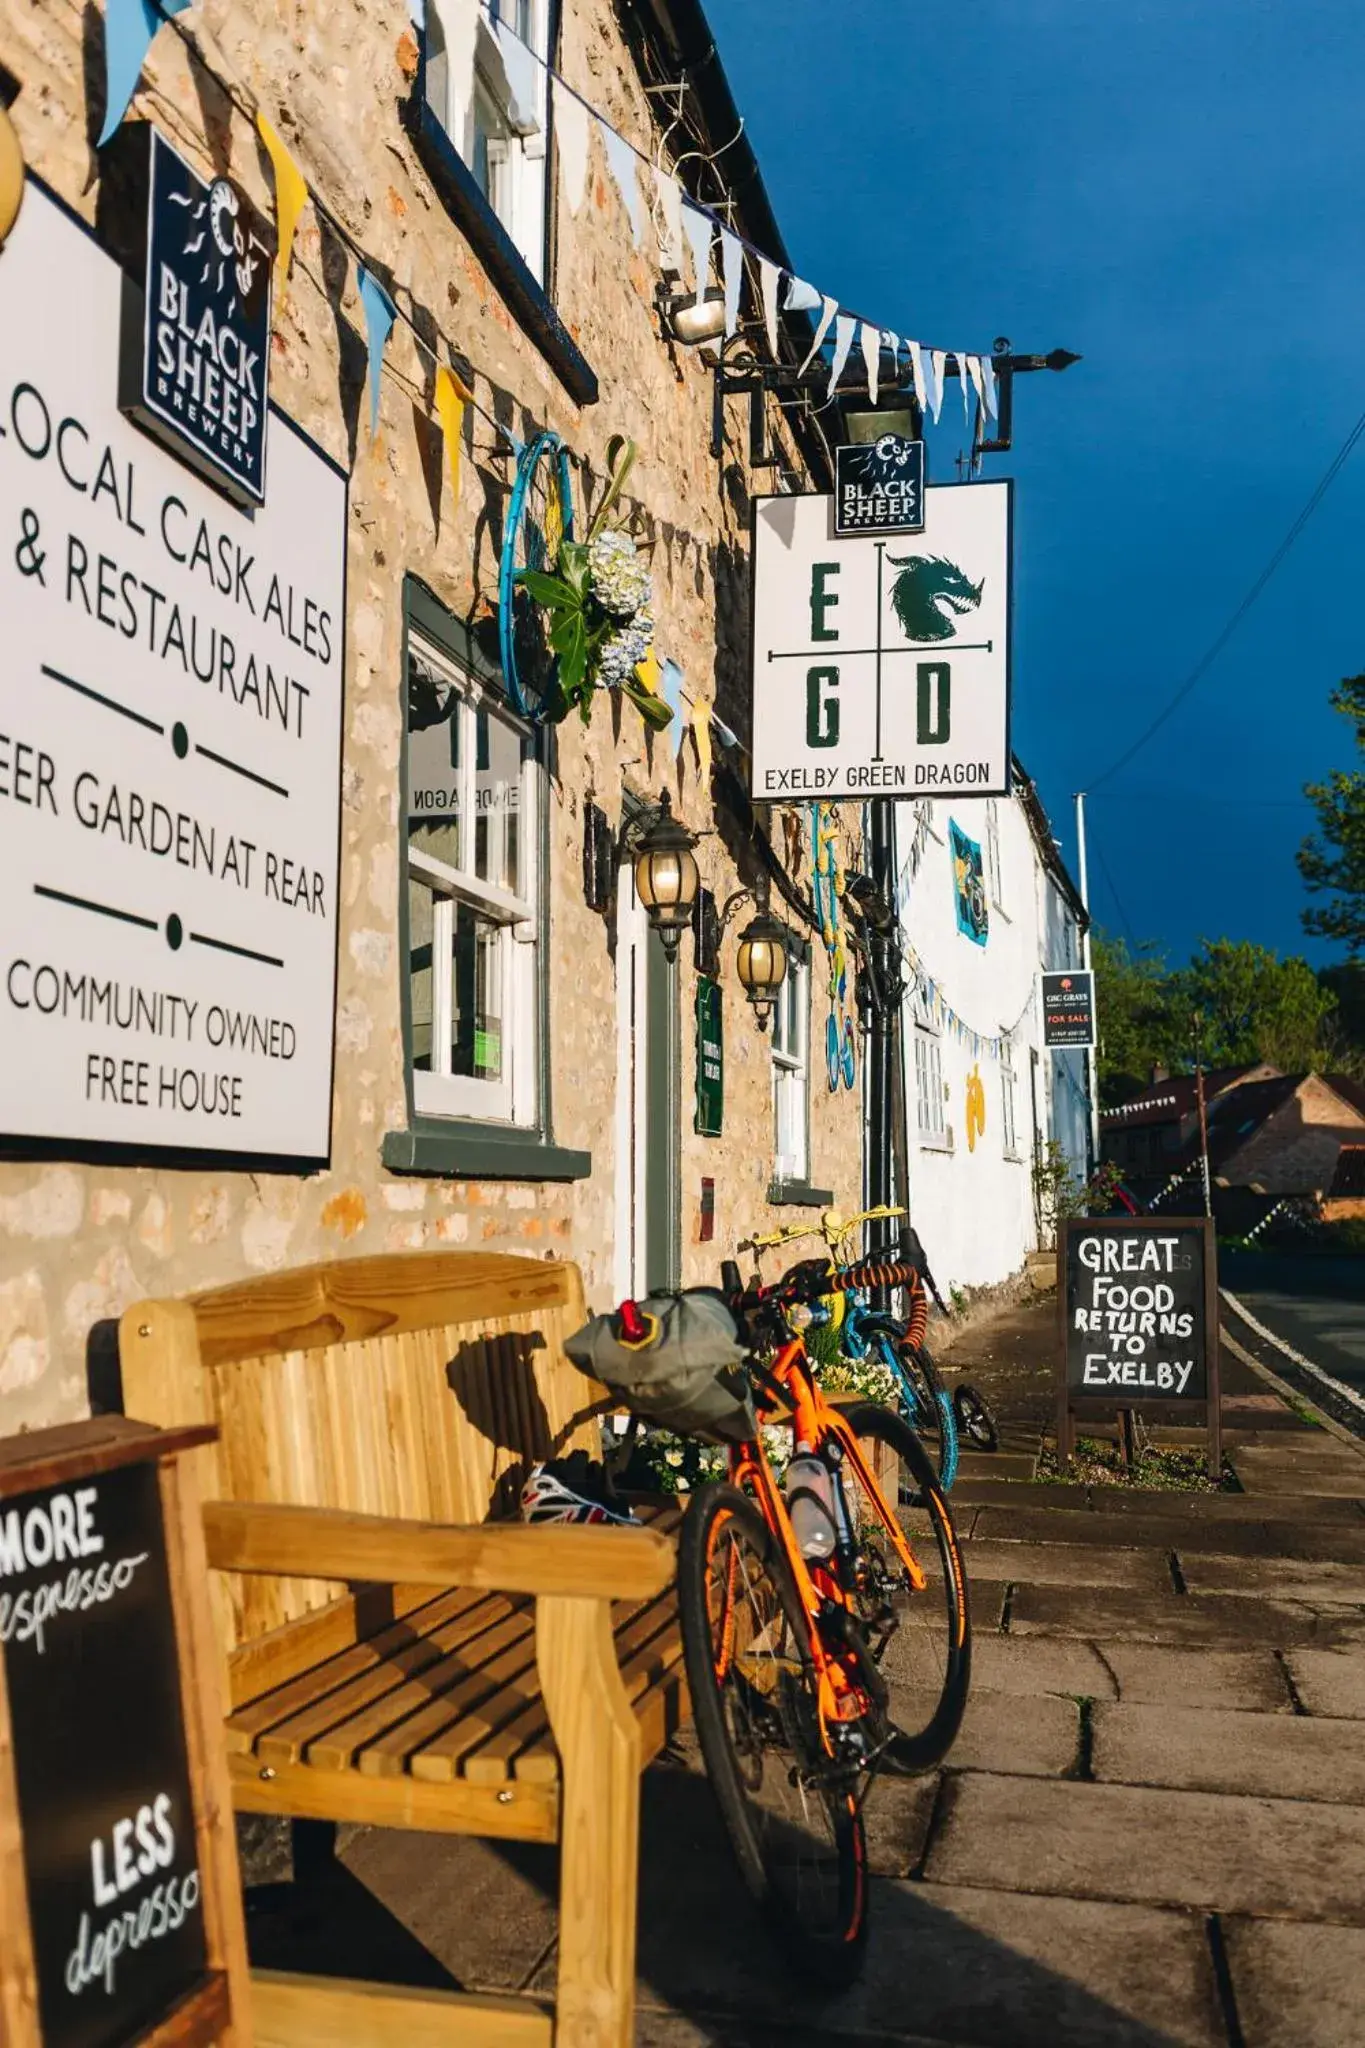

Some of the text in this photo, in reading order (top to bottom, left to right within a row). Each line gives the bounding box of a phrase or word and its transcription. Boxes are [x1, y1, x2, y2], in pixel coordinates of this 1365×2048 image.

[159, 261, 259, 400] BLACK
[157, 321, 257, 445] SHEEP
[158, 381, 255, 470] BREWERY
[0, 382, 331, 665] OCAL CASK ALES
[843, 498, 915, 518] SHEEP
[843, 514, 915, 526] BREWERY
[844, 480, 916, 500] BLACK
[15, 507, 310, 740] & RESTAURANT
[810, 562, 840, 642] E
[806, 662, 951, 748] G D
[765, 763, 990, 790] EXELBY GREEN DRAGON
[74, 771, 215, 876] GARDEN
[220, 835, 256, 889] AT
[265, 851, 326, 918] REAR
[7, 959, 296, 1060] COMMUNITY OWNED
[86, 1054, 243, 1117] FREE HOUSE
[1078, 1237, 1179, 1273] GREAT
[1092, 1276, 1175, 1313] FOOD
[1074, 1307, 1194, 1337] RETURNS
[1109, 1333, 1145, 1355] TO
[1083, 1353, 1194, 1393] EXELBY
[0, 1487, 104, 1576] MORE
[0, 1552, 149, 1654] espresso
[90, 1792, 177, 1908] LESS
[65, 1869, 199, 1995] depresso
